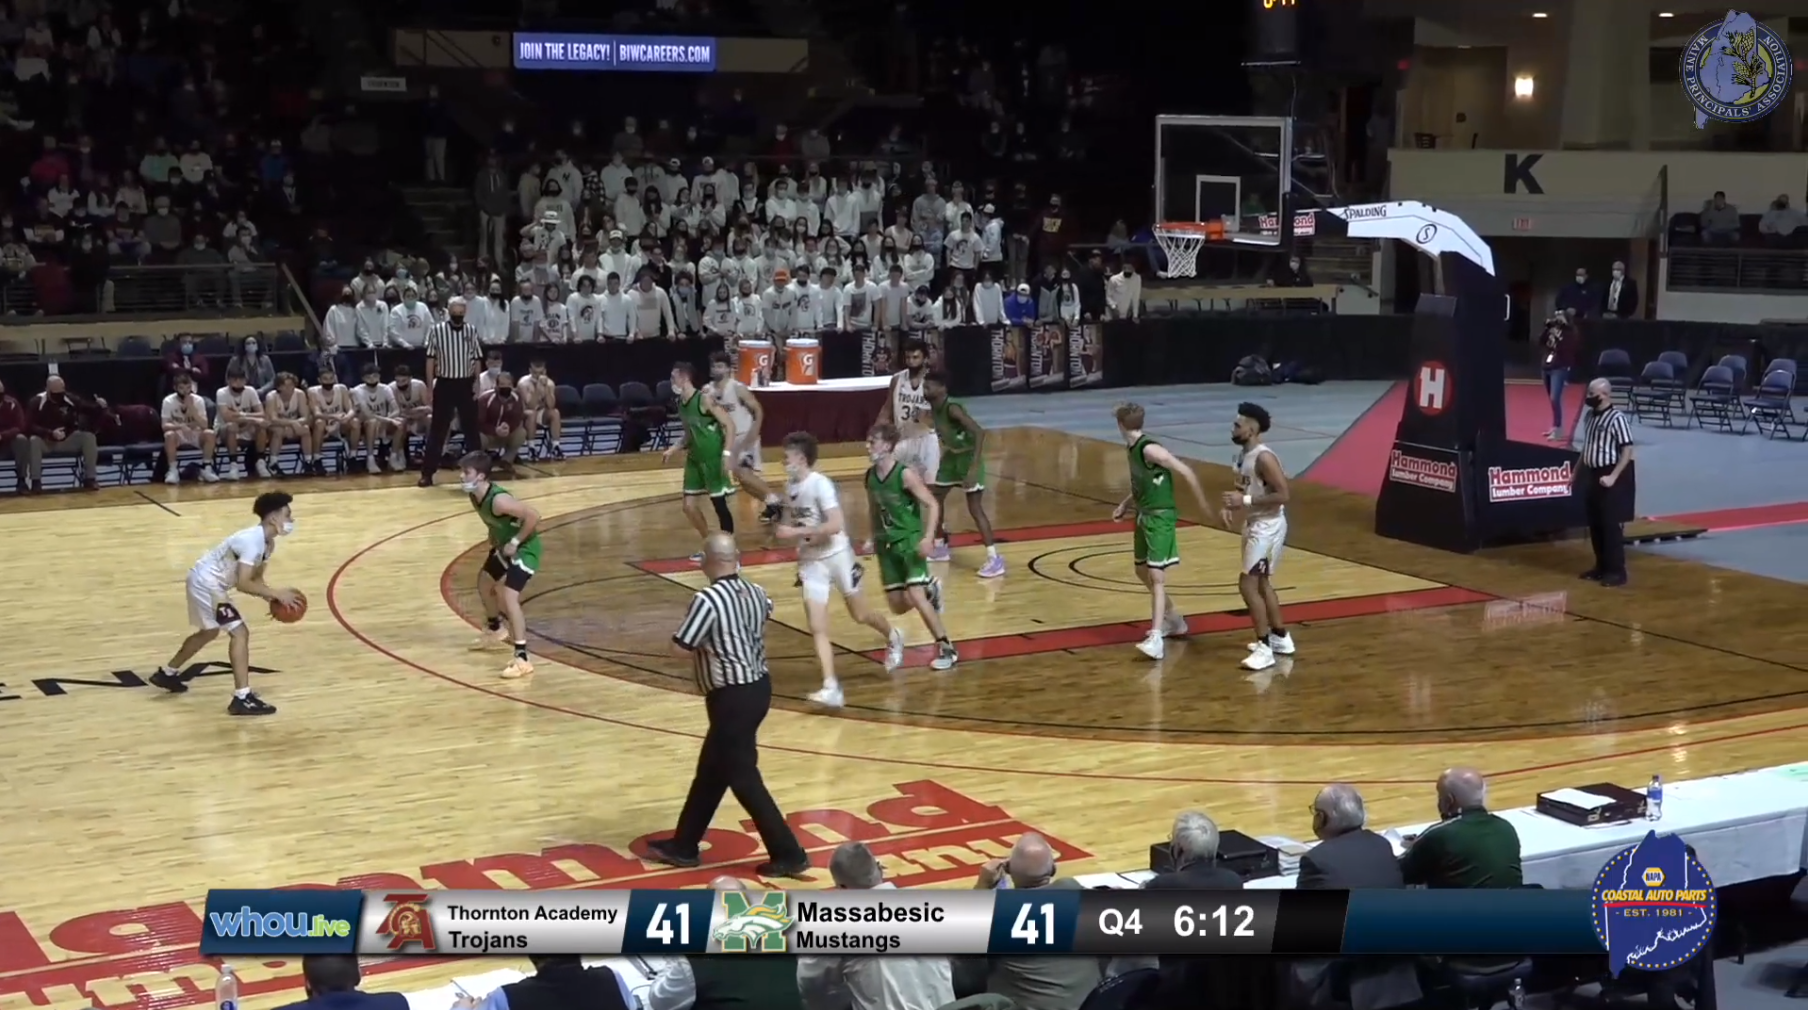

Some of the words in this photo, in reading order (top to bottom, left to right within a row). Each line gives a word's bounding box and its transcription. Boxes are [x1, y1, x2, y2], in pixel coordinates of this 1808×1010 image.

[519, 42, 543, 60] JOIN
[544, 43, 565, 61] THE
[567, 43, 610, 61] LEGACY!
[619, 44, 711, 63] BIWCAREERS.COM
[1504, 153, 1545, 194] K
[1344, 205, 1387, 219] SPALDING
[759, 354, 769, 367] G
[803, 353, 813, 366] G
[1420, 367, 1445, 409] H
[1391, 450, 1457, 478] Hammond
[1489, 461, 1570, 485] Hammond
[1492, 486, 1525, 498] Lumber
[1527, 484, 1569, 496] Company
